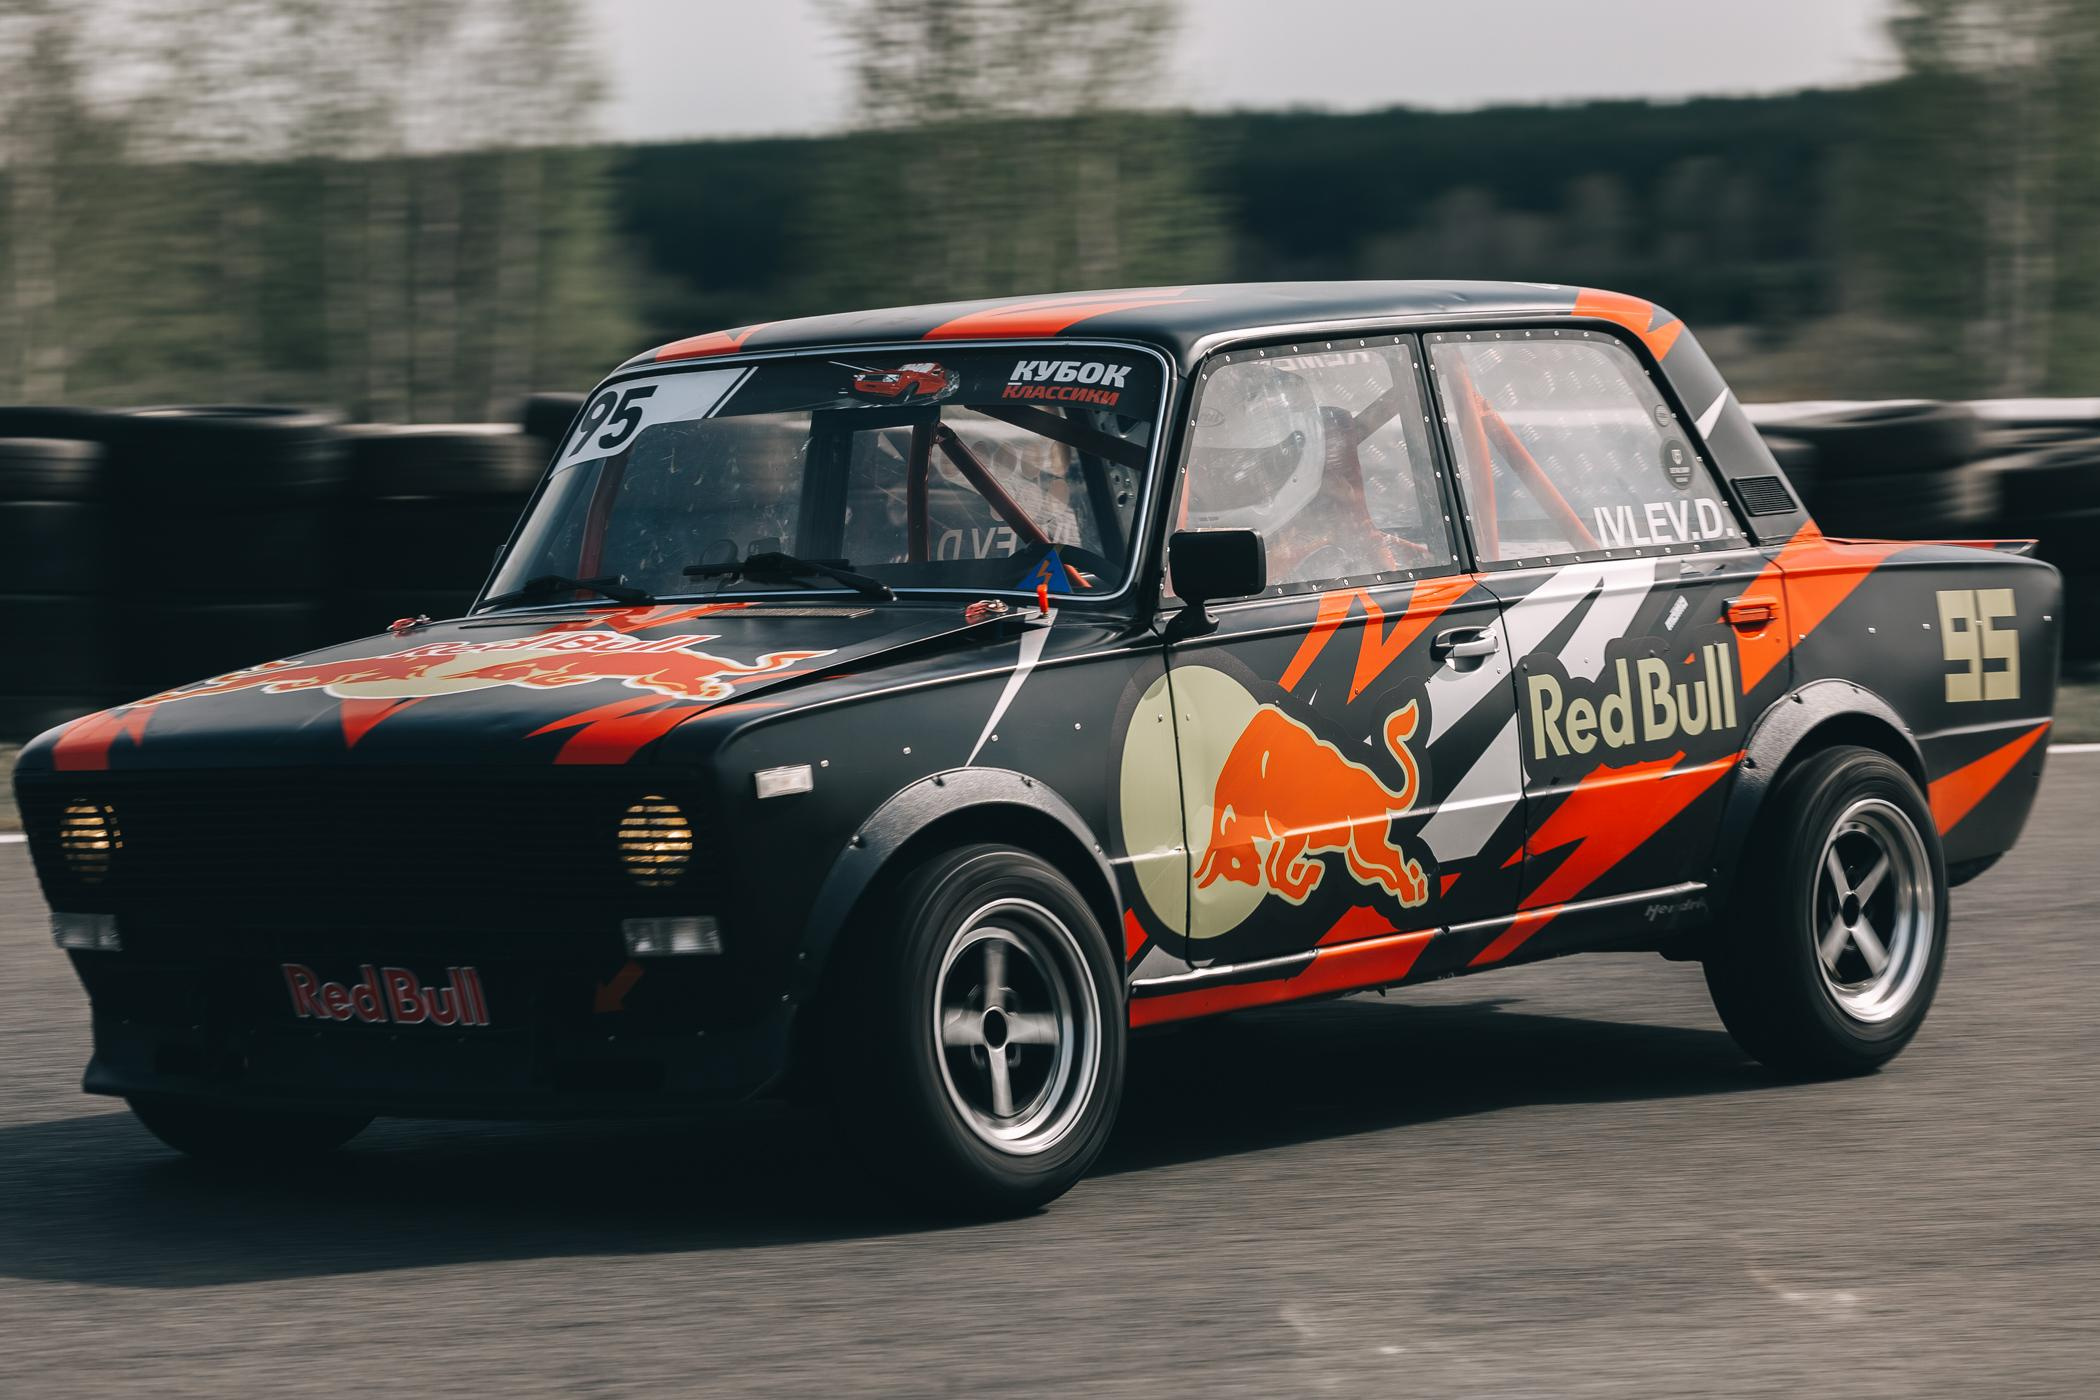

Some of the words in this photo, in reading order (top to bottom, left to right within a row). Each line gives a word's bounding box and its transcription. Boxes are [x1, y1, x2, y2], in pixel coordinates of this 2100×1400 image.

[1002, 384, 1120, 406] КЛАССИКИ
[1009, 360, 1133, 388] КУБОК
[568, 384, 659, 458] 95
[534, 632, 721, 653] Bull
[1936, 588, 2021, 703] 95
[1527, 658, 1636, 760] Red
[1636, 642, 1737, 742] Bull
[282, 963, 388, 1021] Red
[381, 966, 490, 1026] Bull
